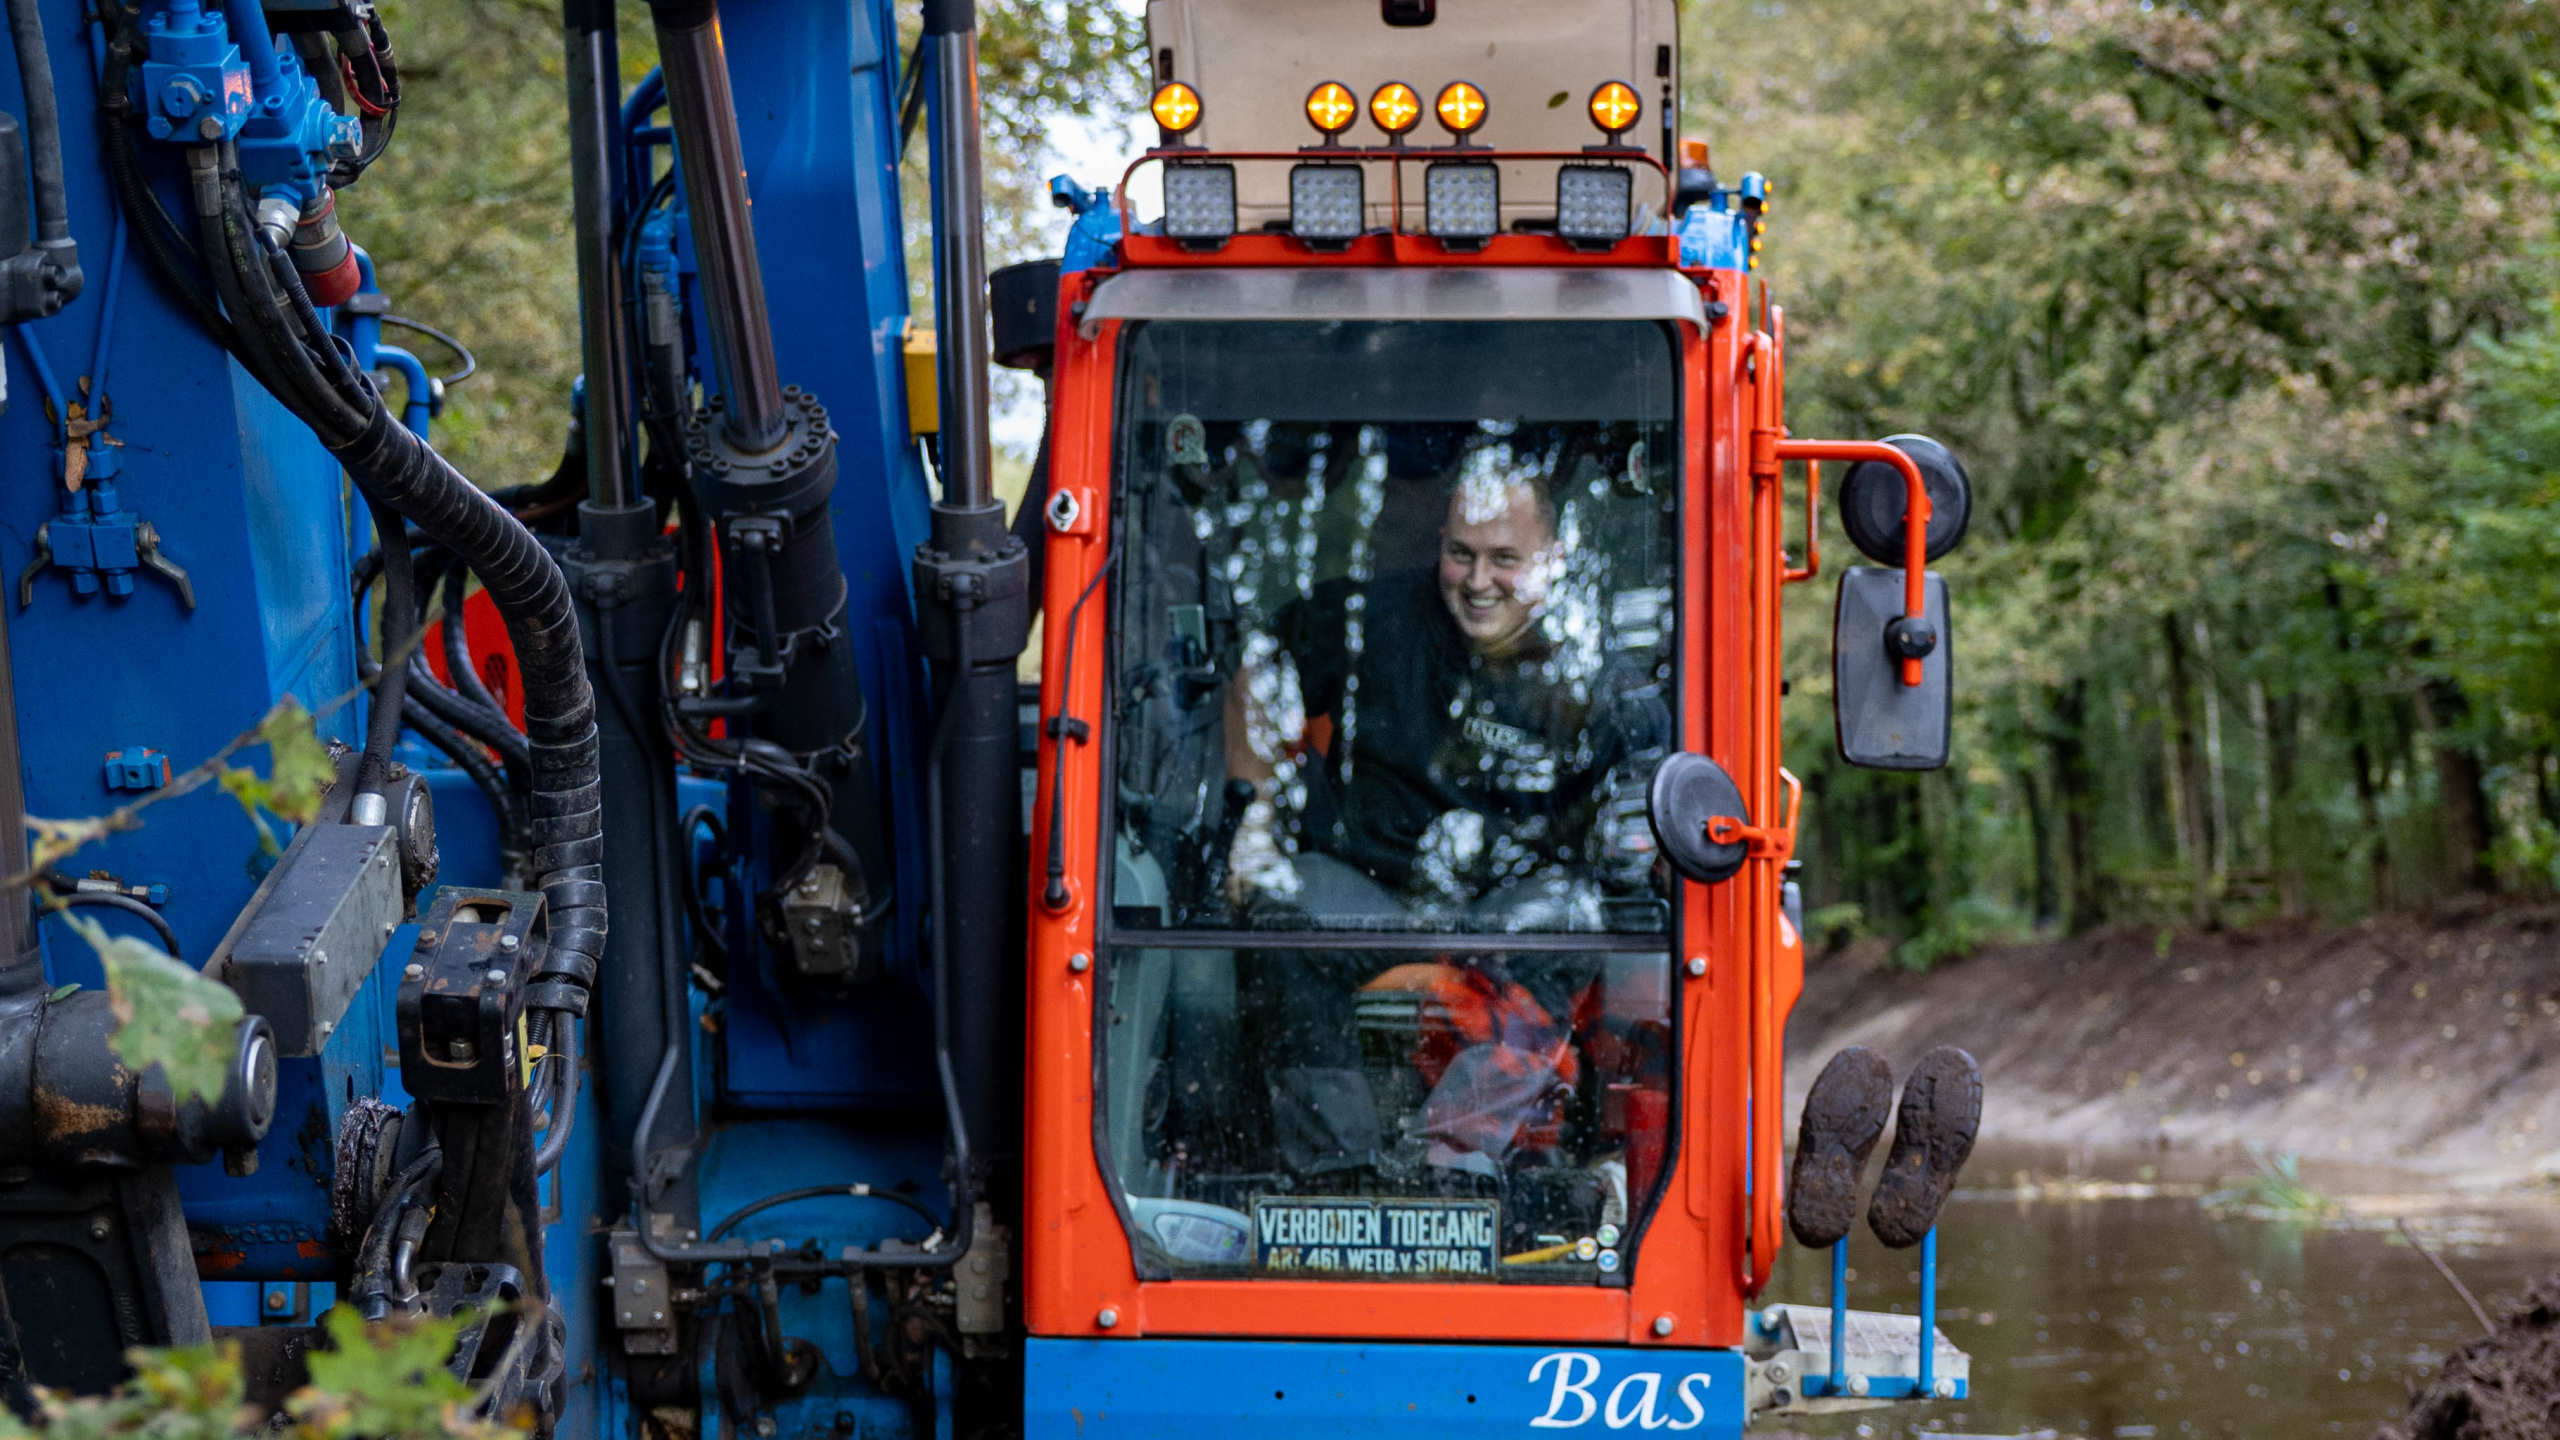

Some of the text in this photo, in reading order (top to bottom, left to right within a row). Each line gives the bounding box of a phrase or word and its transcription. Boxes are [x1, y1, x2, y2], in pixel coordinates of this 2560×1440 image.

[1259, 1207, 1492, 1247] VERBODEN TOEGANG
[1527, 1351, 1712, 1431] Bas
